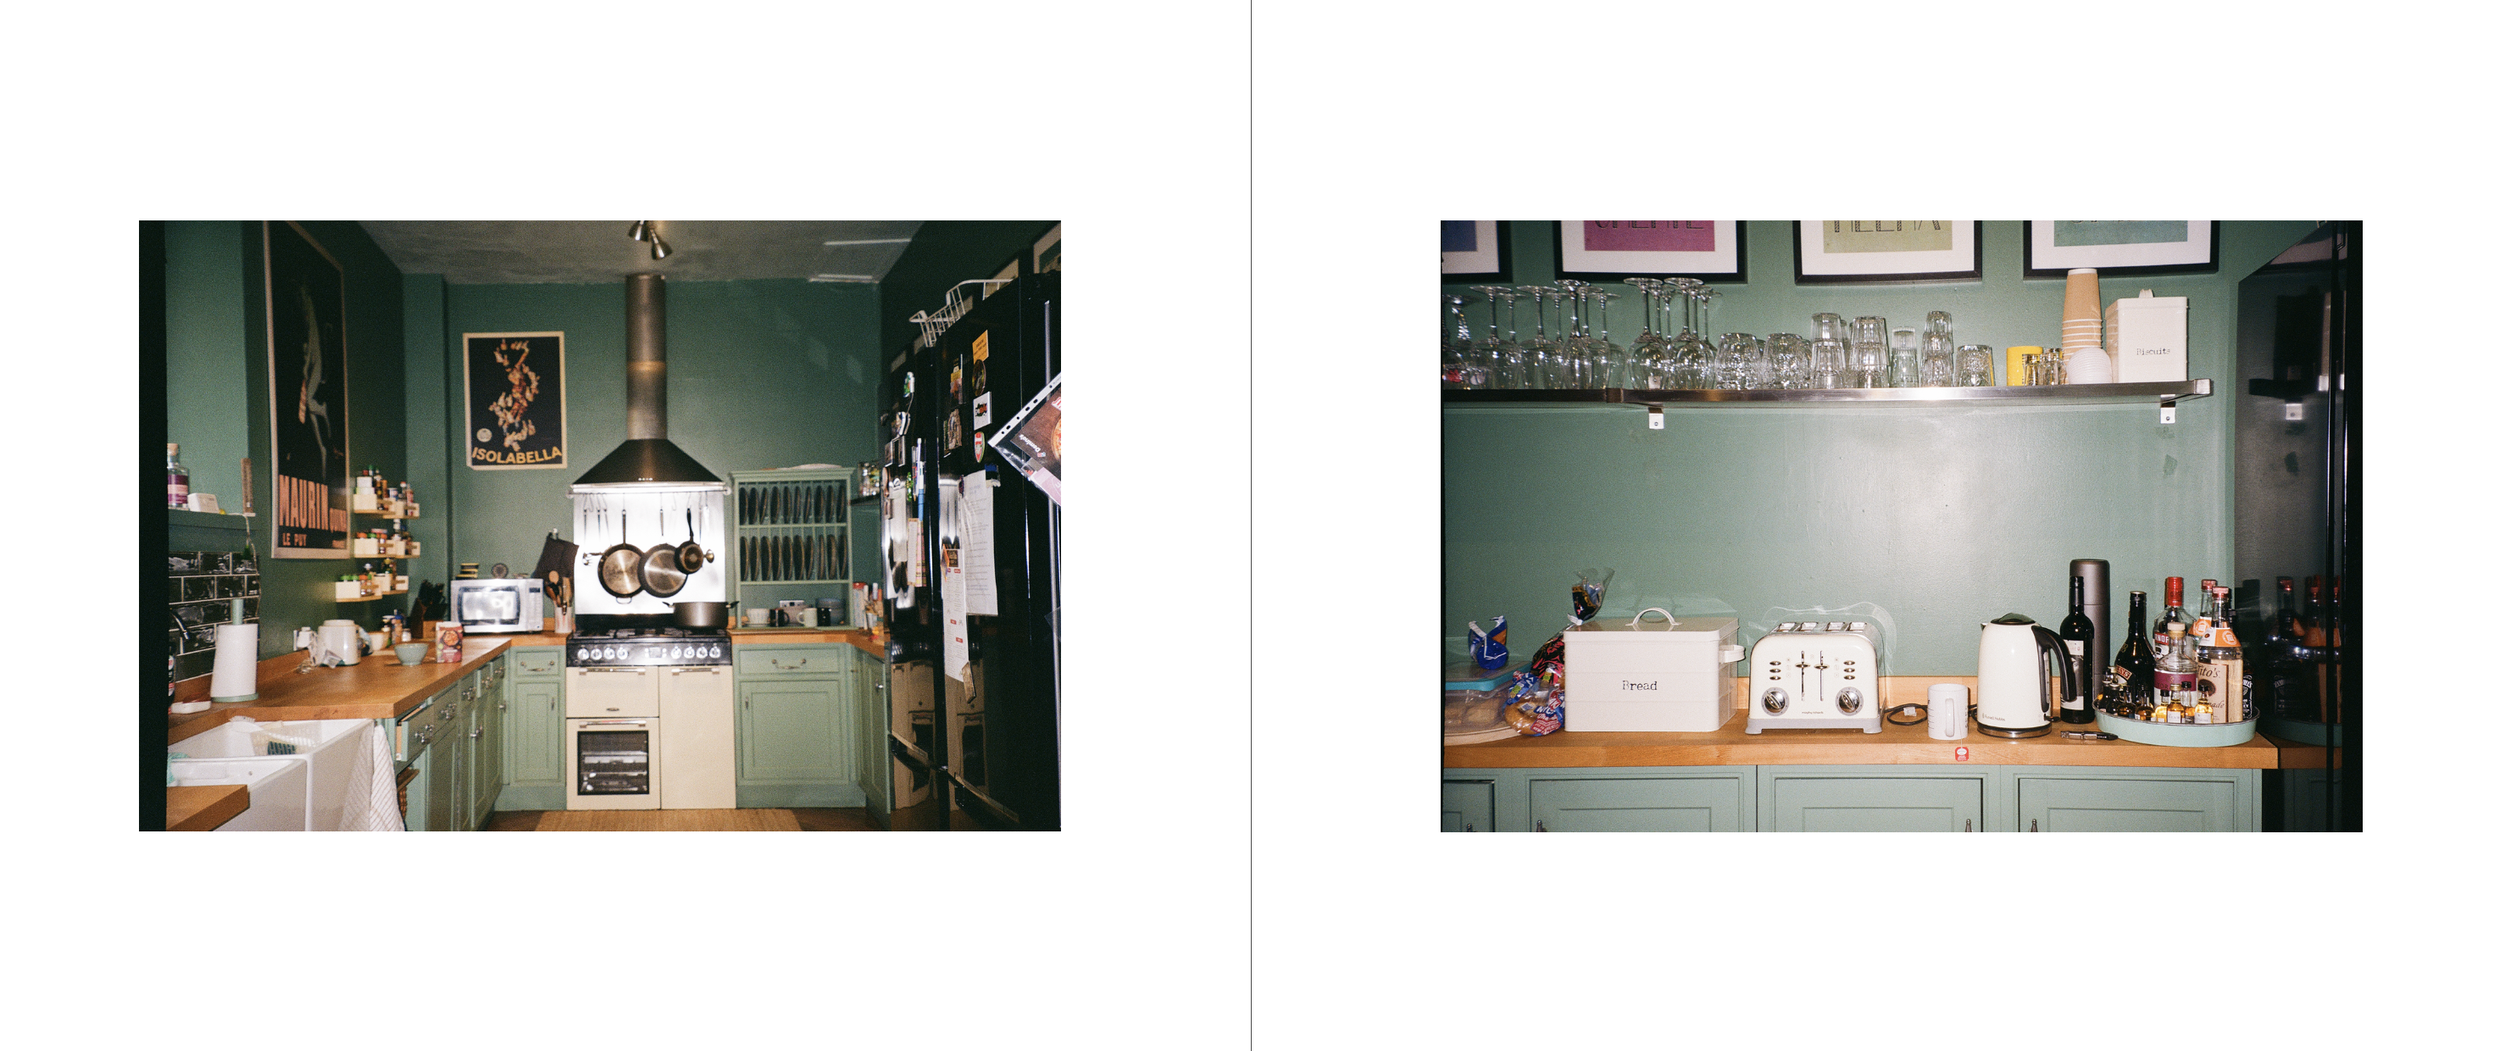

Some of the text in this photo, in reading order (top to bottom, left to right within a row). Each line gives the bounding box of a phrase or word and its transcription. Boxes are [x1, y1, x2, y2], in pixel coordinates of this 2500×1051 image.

[2136, 347, 2171, 356] Biscuits
[472, 446, 562, 464] ISOLABELLA
[279, 474, 329, 531] MAURIN
[1622, 679, 1658, 691] Bread
